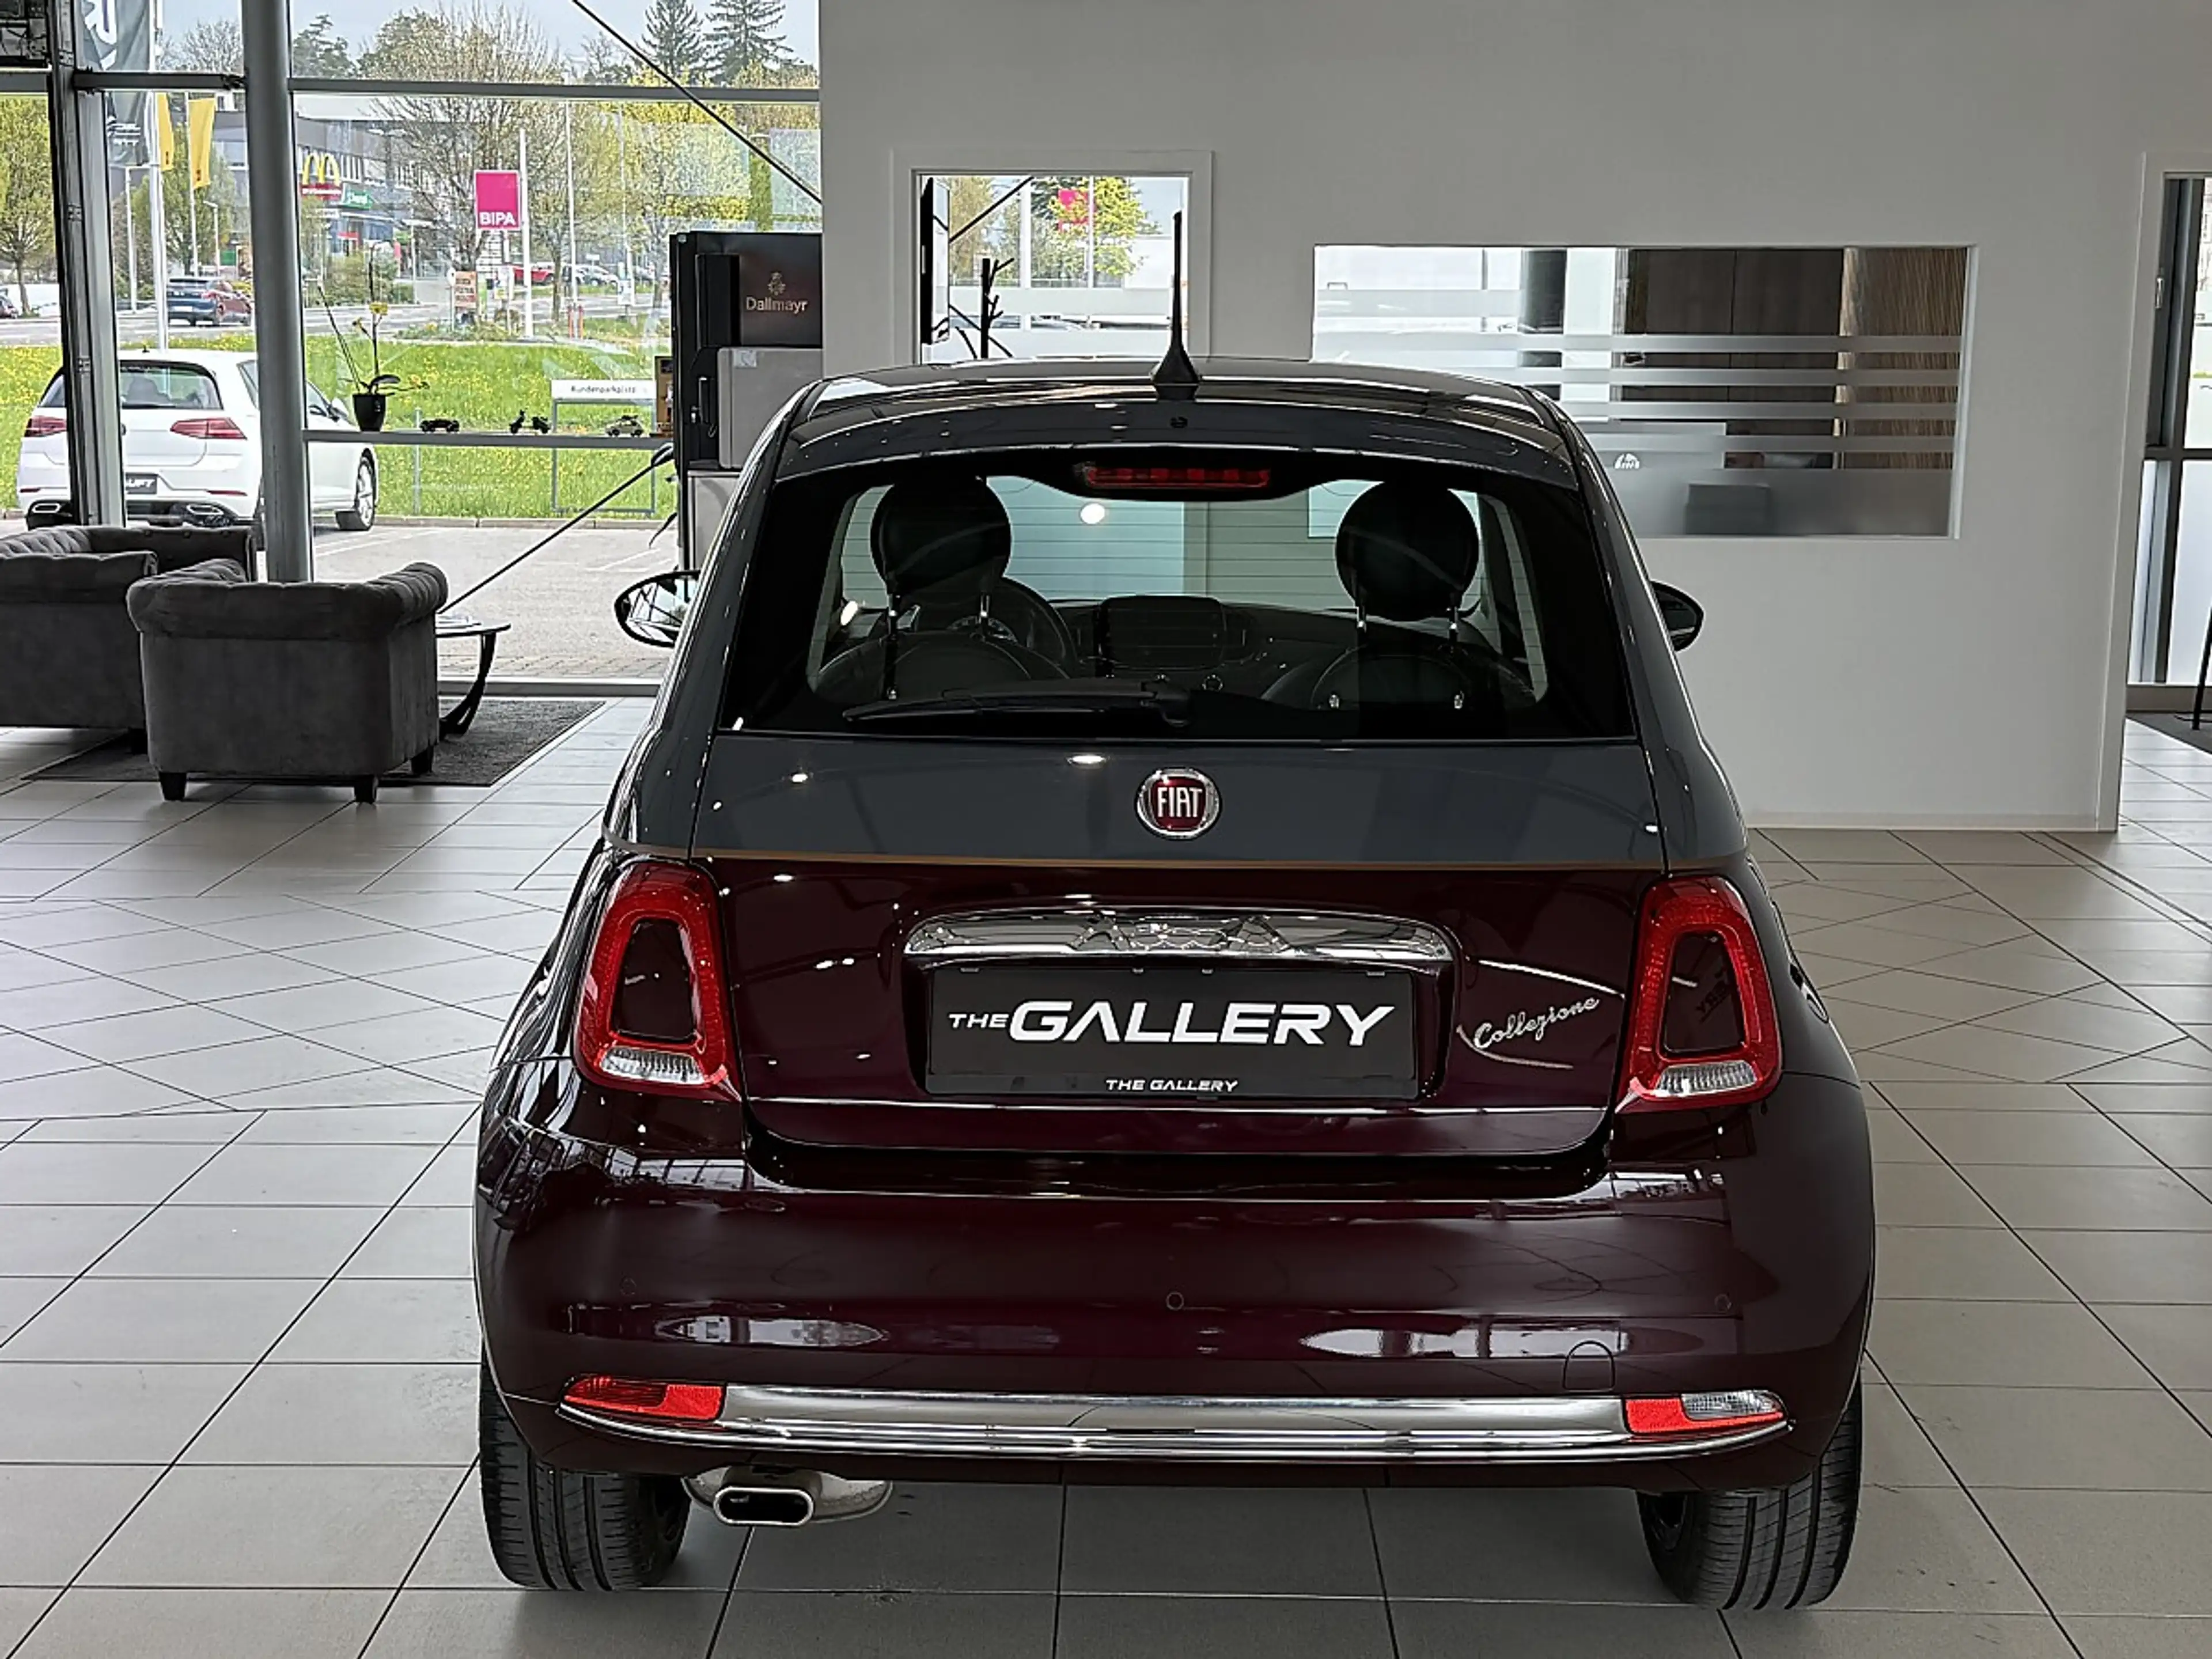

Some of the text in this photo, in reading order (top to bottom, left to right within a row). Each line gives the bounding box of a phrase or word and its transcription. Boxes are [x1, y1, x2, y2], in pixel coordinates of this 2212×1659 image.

[479, 211, 517, 226] BIPA
[747, 296, 808, 315] Dallmayr
[1157, 787, 1203, 817] FIAT
[949, 1001, 1395, 1046] THE GALLERY
[1105, 1079, 1238, 1092] THE GALLERY
